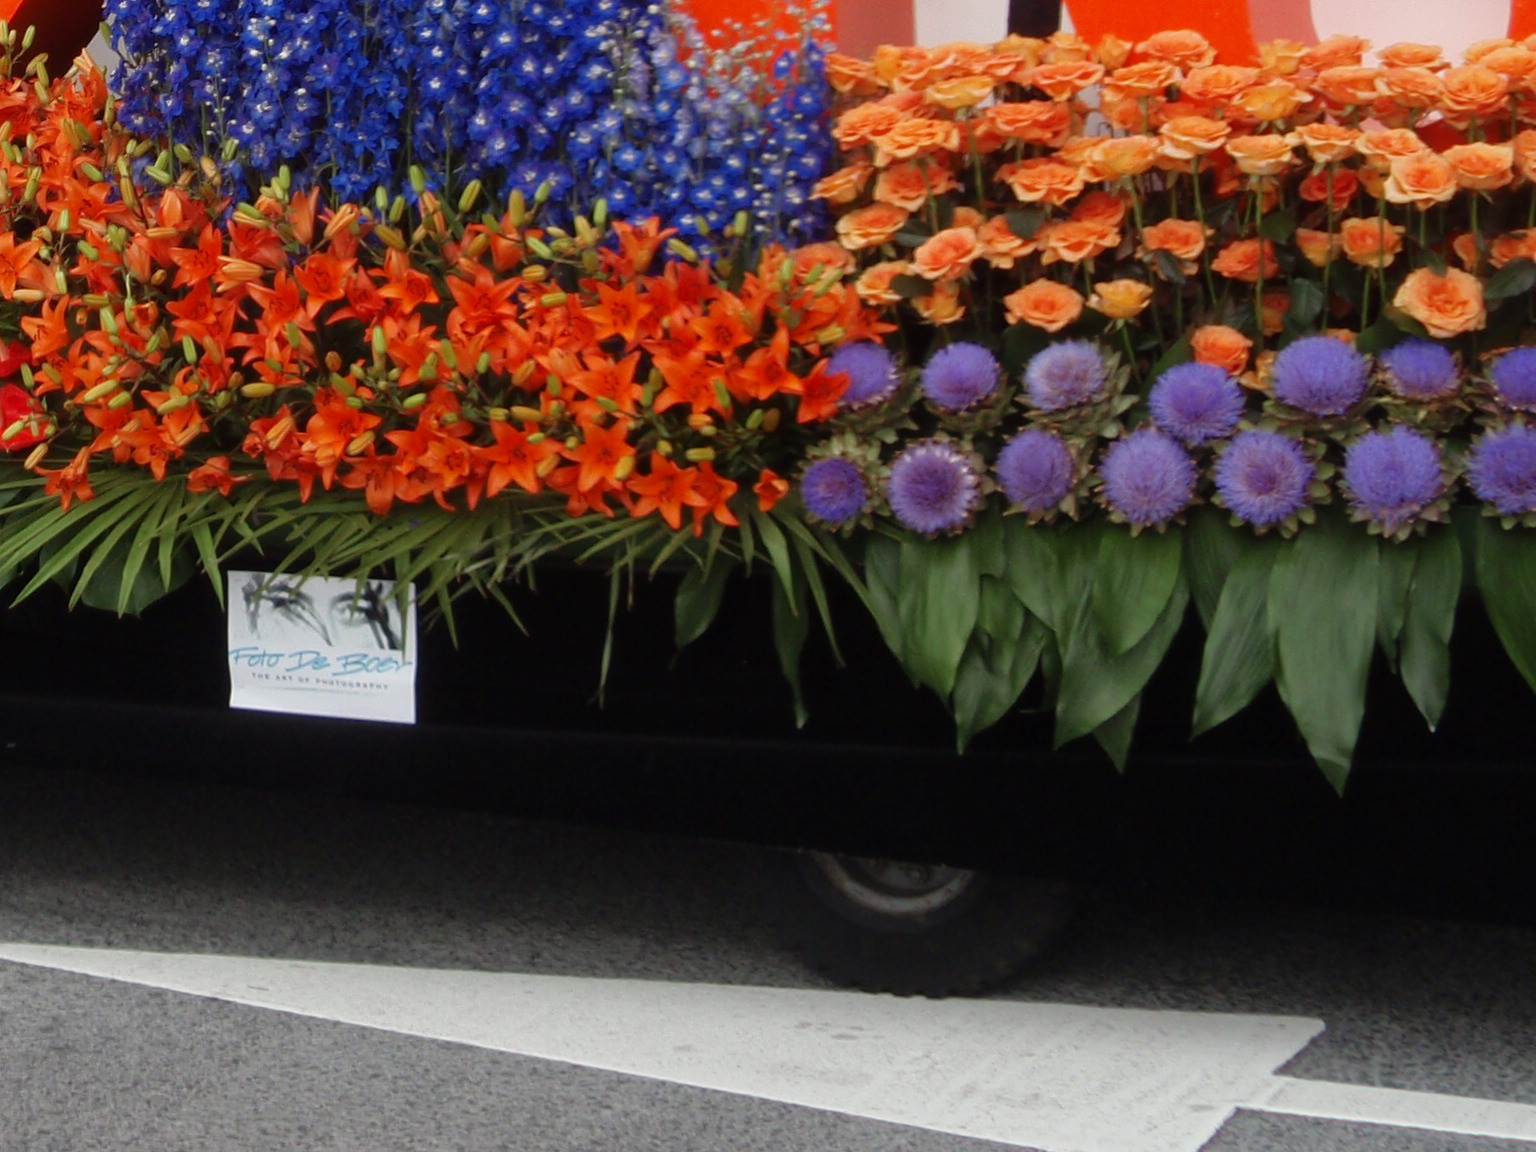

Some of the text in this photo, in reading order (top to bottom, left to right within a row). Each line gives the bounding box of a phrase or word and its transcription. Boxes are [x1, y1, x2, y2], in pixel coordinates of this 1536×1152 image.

[228, 647, 413, 677] Foto De Boer
